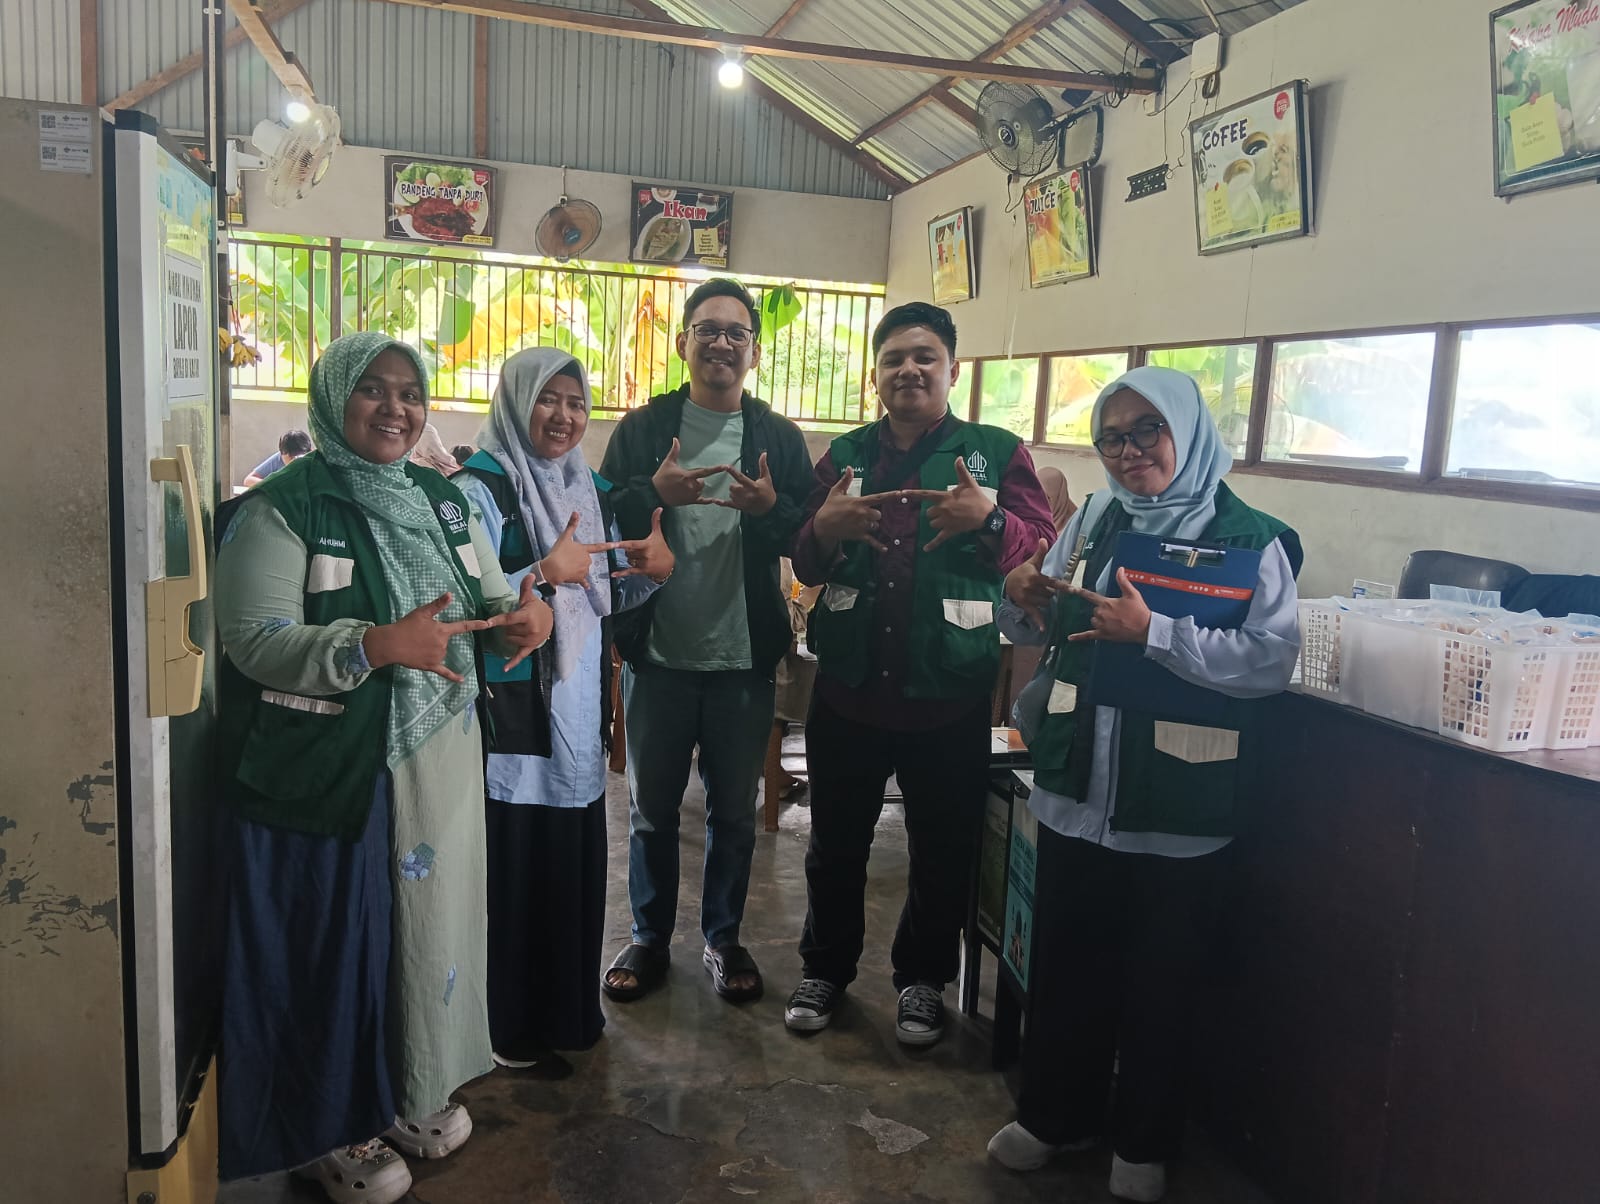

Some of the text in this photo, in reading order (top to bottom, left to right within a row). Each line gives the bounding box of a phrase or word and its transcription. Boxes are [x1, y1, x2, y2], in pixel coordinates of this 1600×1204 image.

[1556, 0, 1599, 34] Muda
[1202, 118, 1248, 151] COFEE
[401, 183, 484, 202] BANDENG TANPA DURI
[1029, 190, 1056, 215] JUICE
[663, 200, 708, 221] Ikan
[173, 302, 198, 351] LAPOR
